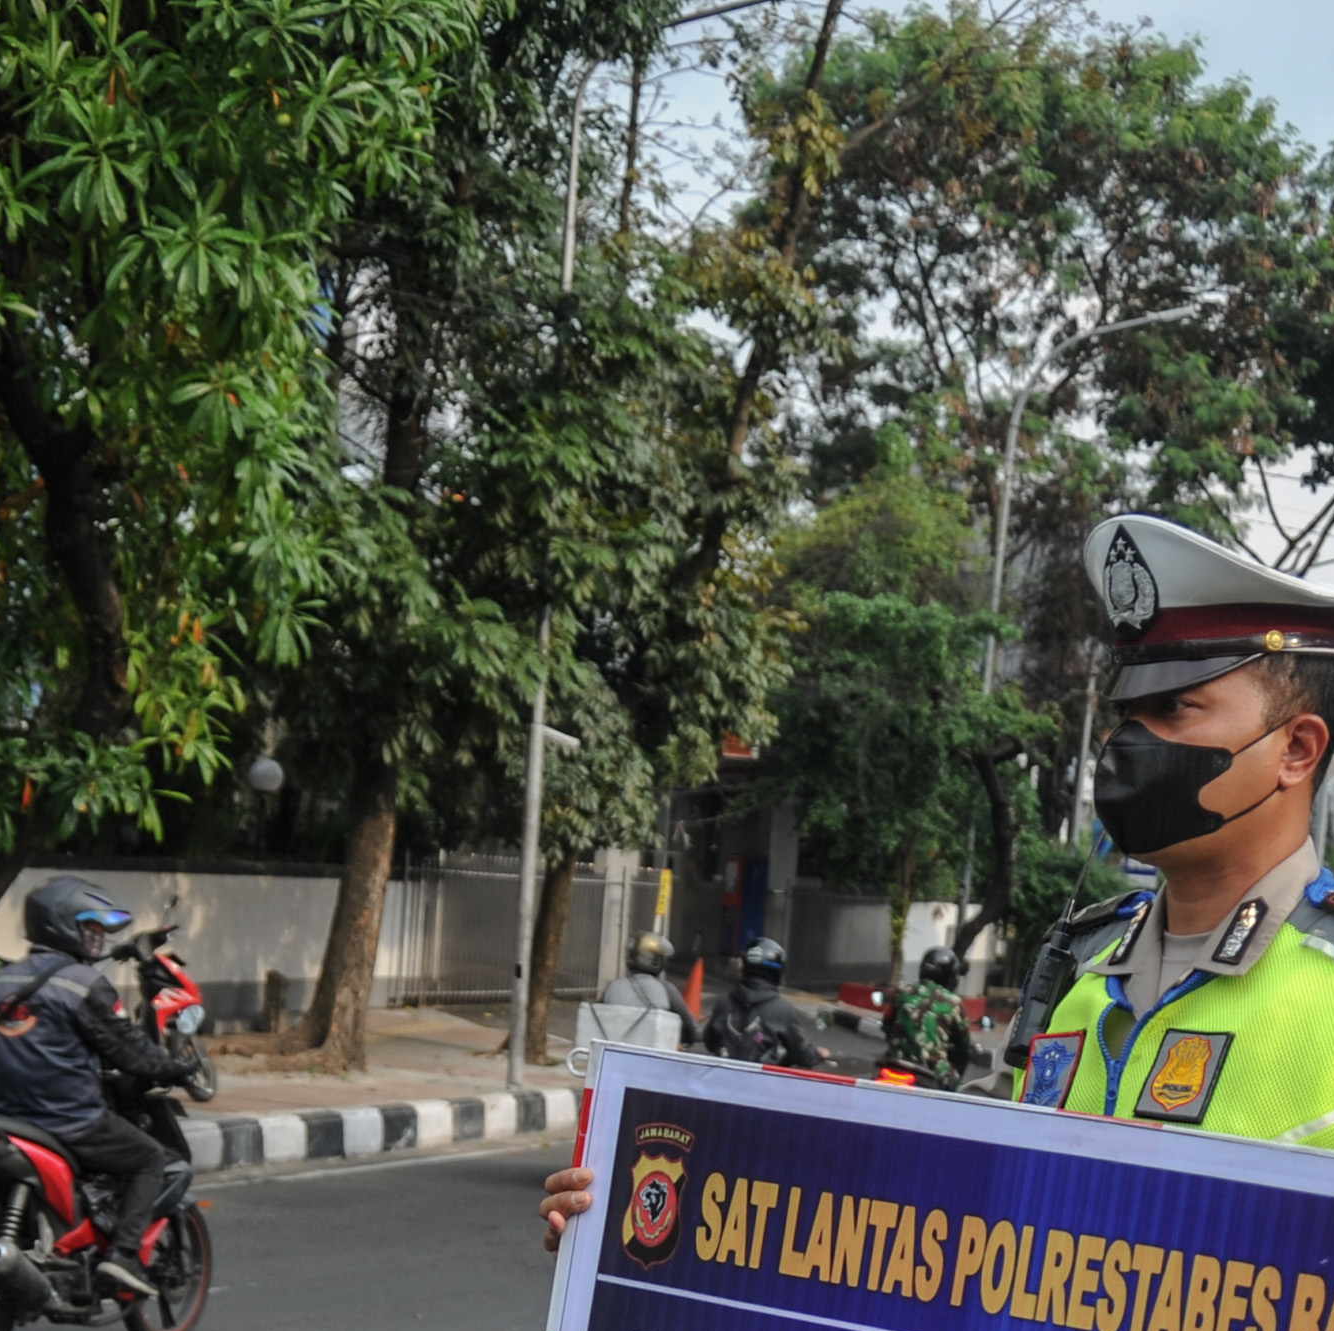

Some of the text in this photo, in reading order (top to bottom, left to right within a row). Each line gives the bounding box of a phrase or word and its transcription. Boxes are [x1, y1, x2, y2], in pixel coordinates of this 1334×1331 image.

[1161, 1083, 1193, 1093] POLISI
[695, 1172, 778, 1268] SAT
[778, 1186, 948, 1302] LANTAS
